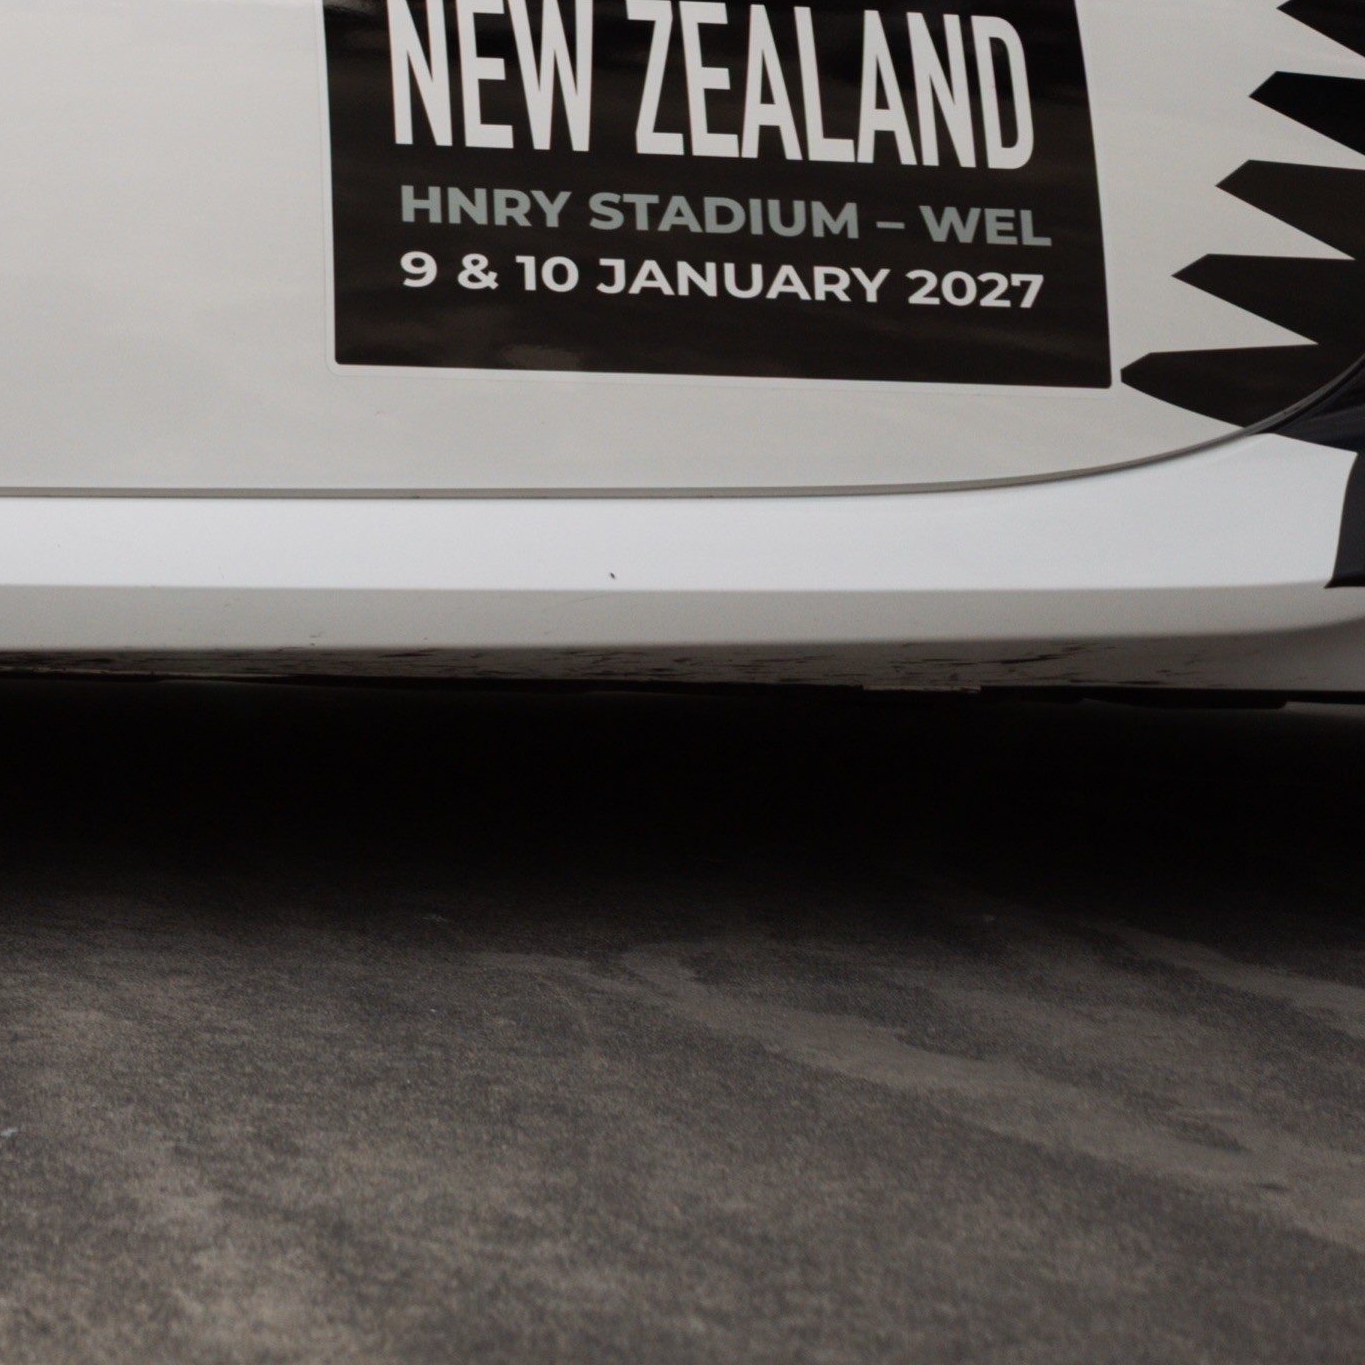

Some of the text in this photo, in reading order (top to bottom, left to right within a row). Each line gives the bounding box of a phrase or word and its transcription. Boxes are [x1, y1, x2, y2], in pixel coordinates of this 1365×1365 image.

[401, 185, 571, 228] HNRY
[588, 192, 860, 239] STADIUM
[919, 205, 1052, 246] WEL
[400, 251, 1045, 308] 9 & 10 JANUARY 2027
